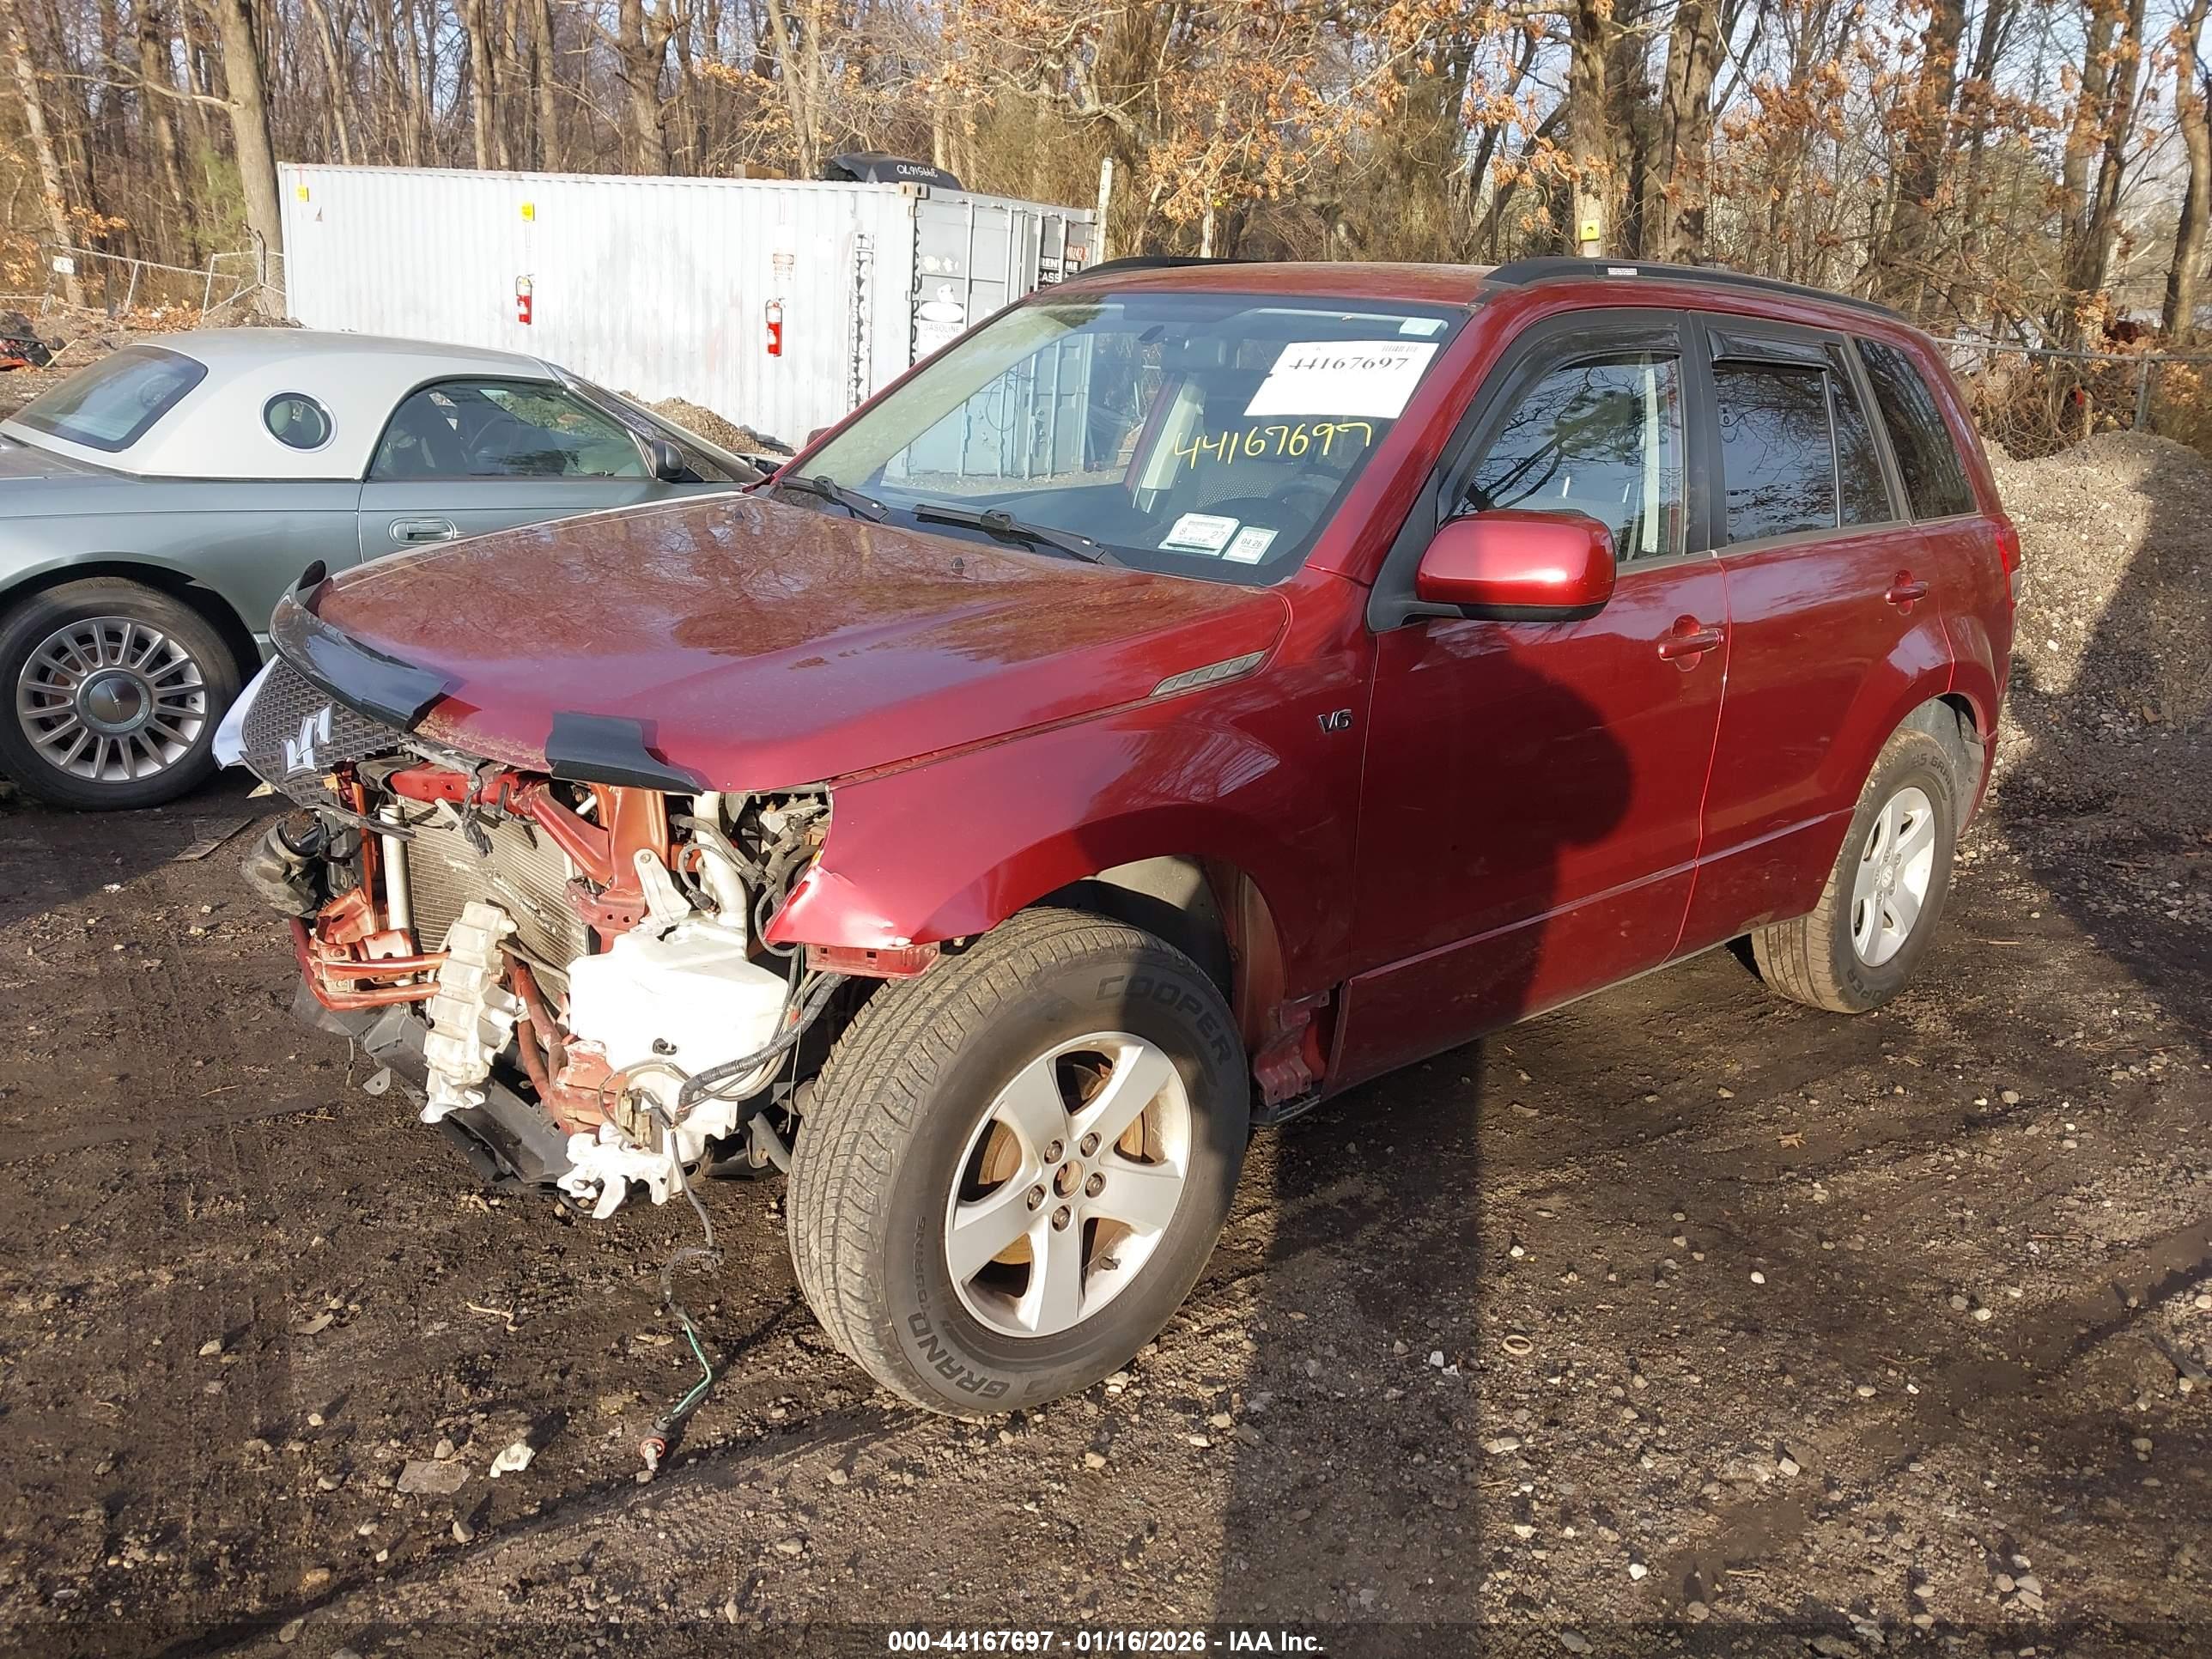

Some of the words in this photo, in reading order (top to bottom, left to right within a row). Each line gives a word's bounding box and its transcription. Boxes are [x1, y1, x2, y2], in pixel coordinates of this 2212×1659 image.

[1065, 260, 1079, 271] ME
[1288, 356, 1410, 371] 44167697
[1174, 421, 1372, 470] 44167697
[1317, 708, 1353, 734] V6
[1096, 975, 1233, 1066] COOPER
[908, 1311, 1011, 1400] GRAND
